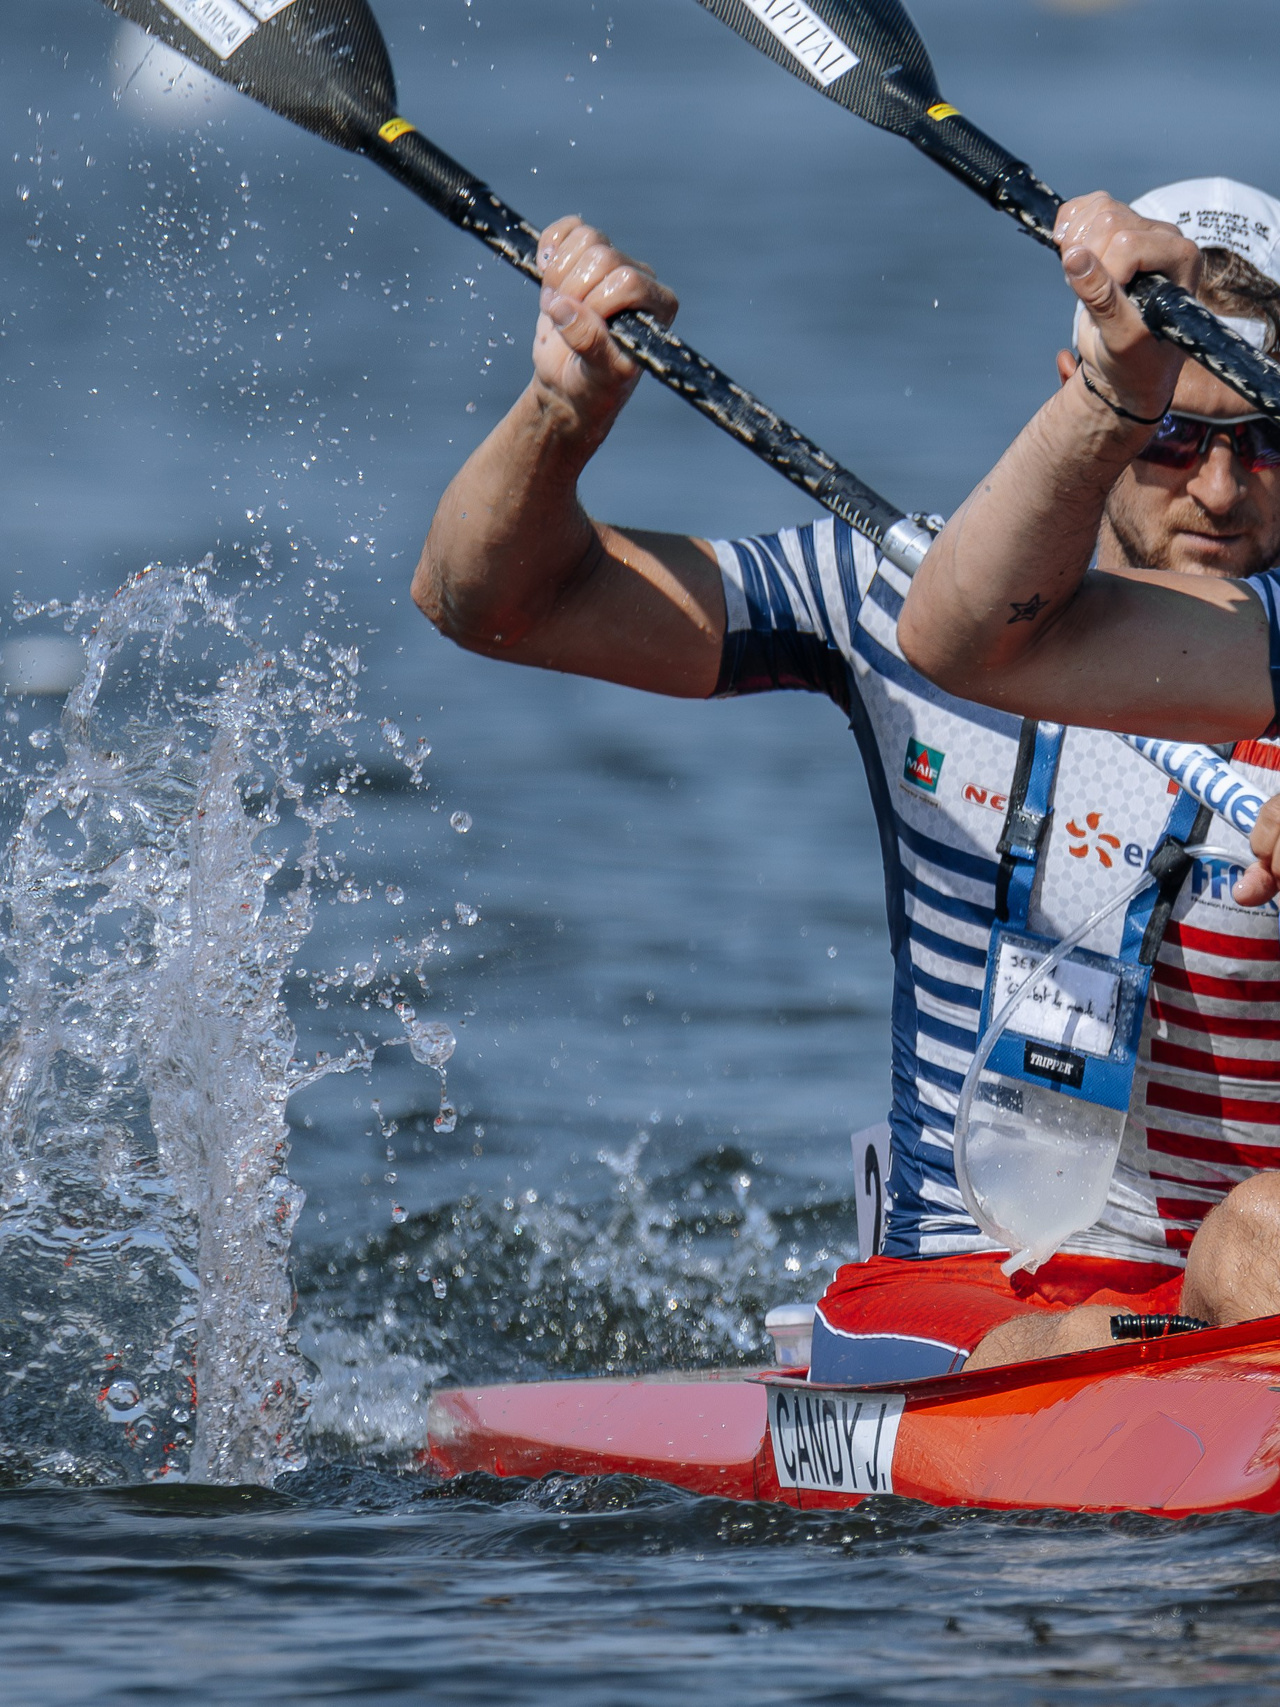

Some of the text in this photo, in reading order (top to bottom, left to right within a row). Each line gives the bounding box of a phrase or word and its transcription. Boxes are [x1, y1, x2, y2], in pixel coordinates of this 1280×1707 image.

[906, 756, 939, 780] MAIF
[964, 783, 1008, 811] NE
[1029, 1053, 1074, 1076] TRIPPER
[776, 1392, 887, 1491] CANDY J.
